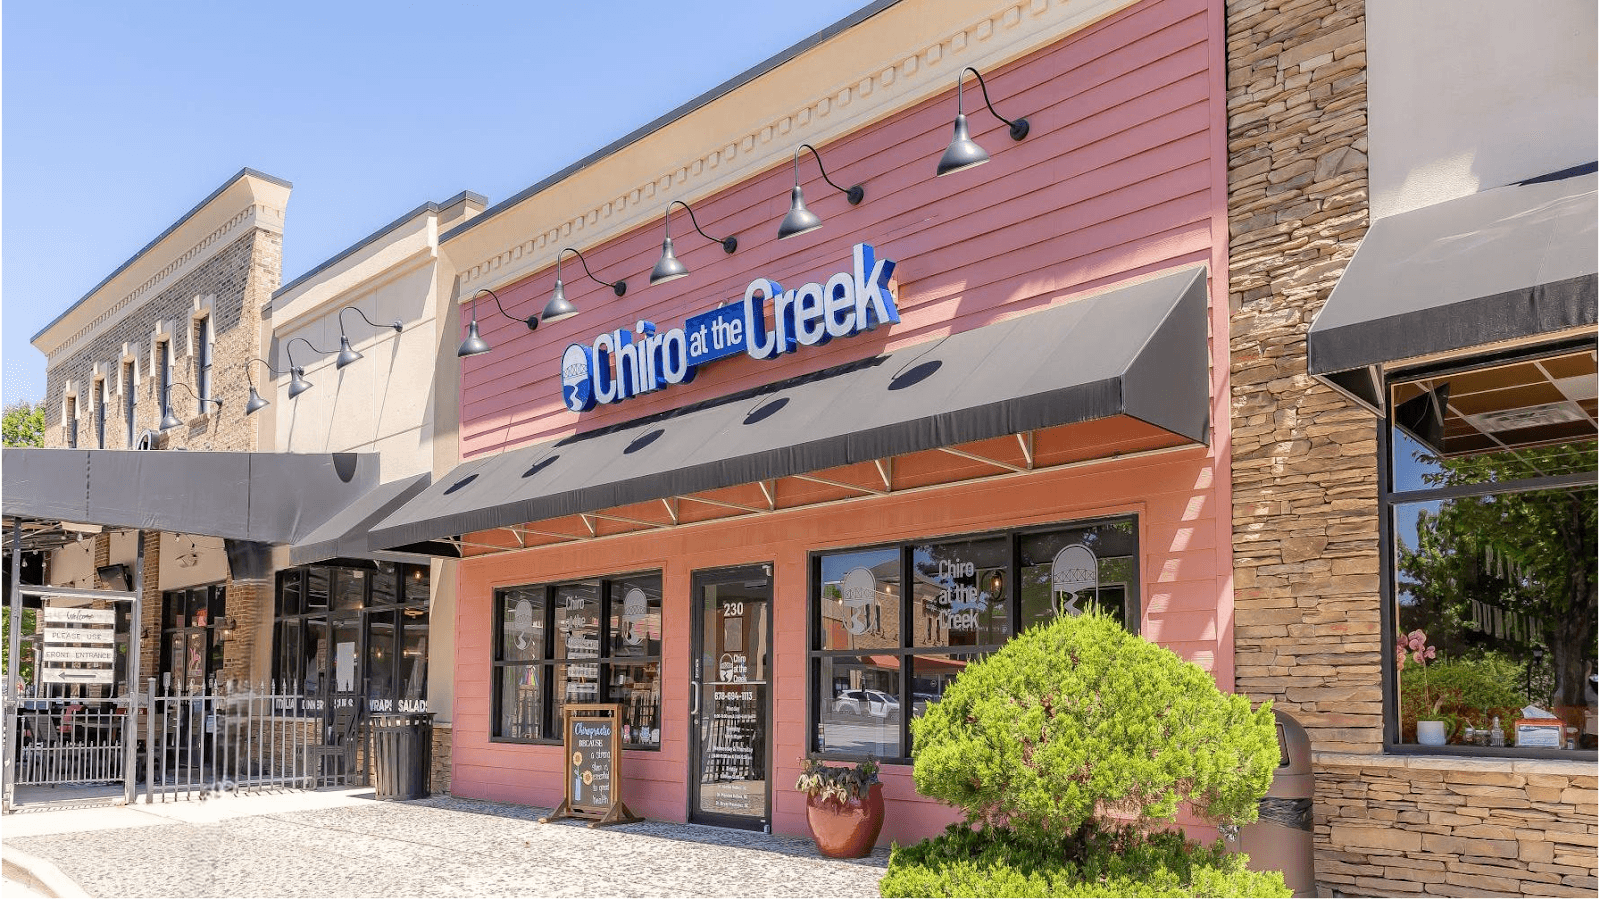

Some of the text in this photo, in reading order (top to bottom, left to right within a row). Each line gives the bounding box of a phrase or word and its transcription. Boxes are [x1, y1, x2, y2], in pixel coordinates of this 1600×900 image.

[592, 242, 897, 404] Chiro at the Creek
[939, 558, 975, 579] Chiro
[938, 583, 978, 605] at the
[565, 596, 585, 611] Chiro
[723, 602, 744, 617] 230
[66, 609, 95, 621] Welcome
[938, 608, 979, 630] Creek
[52, 632, 102, 641] PLEASE USE
[733, 653, 747, 663] Chiro
[578, 739, 604, 747] BECAUSE
